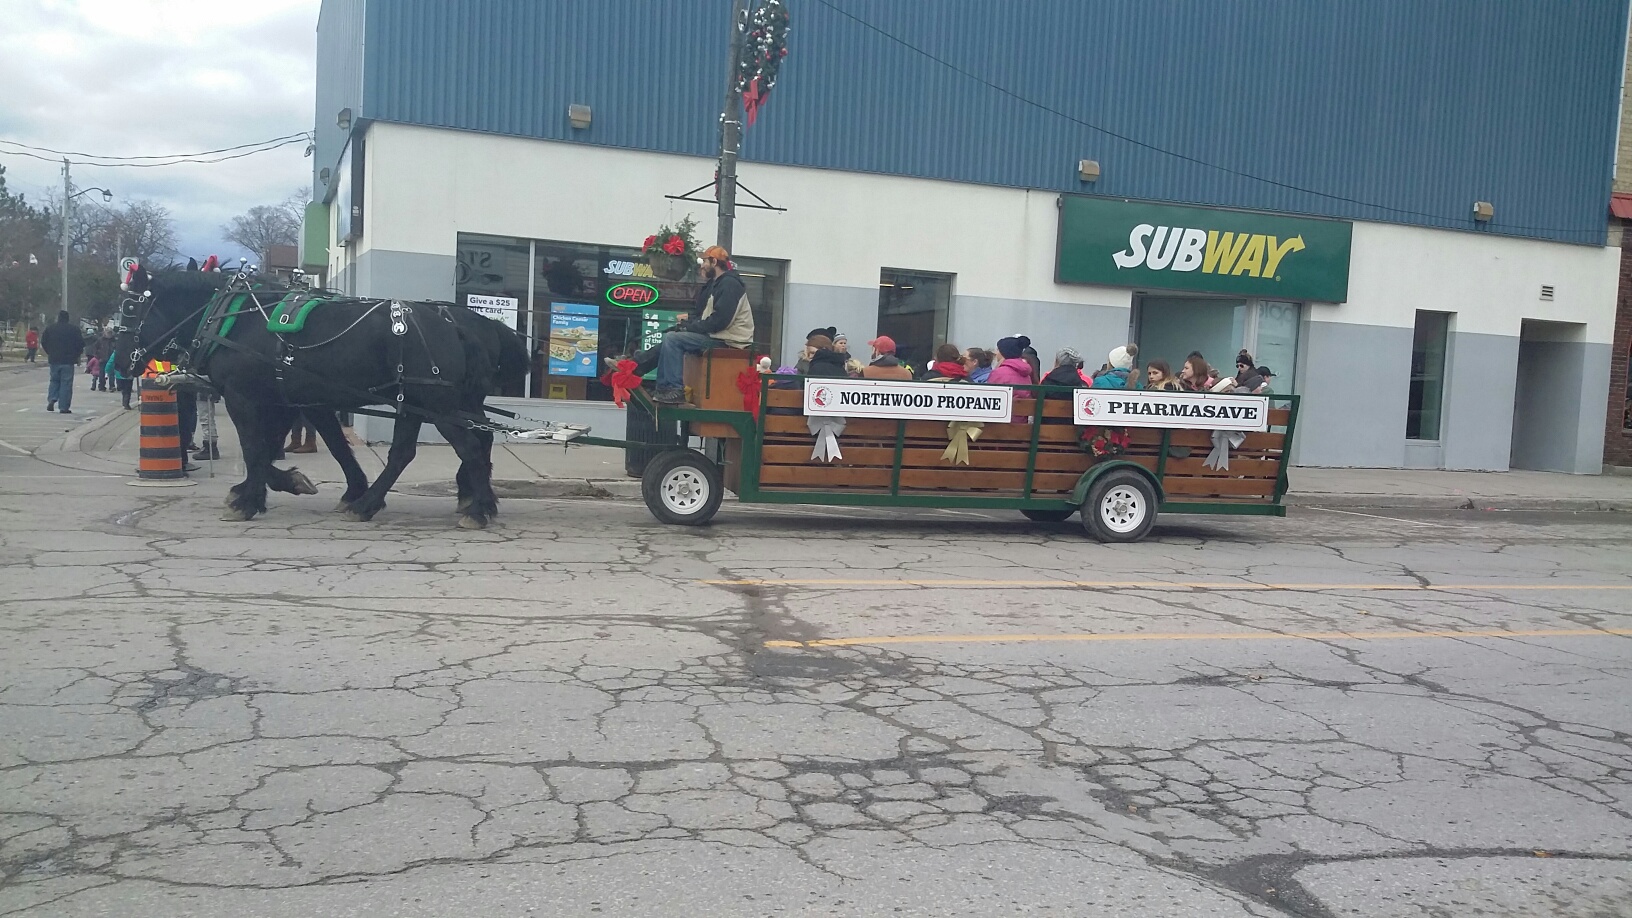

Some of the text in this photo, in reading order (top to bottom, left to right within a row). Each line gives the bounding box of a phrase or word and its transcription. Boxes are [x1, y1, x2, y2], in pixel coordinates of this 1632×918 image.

[1112, 224, 1305, 278] SUBWAY
[604, 260, 657, 278] SUBWA
[470, 297, 487, 305] Give
[495, 299, 510, 307] $25
[613, 287, 652, 302] OPEN
[840, 391, 933, 408] NORTHWOOD
[937, 395, 1001, 411] PROPANE
[1107, 401, 1258, 420] PHARMASAVE
